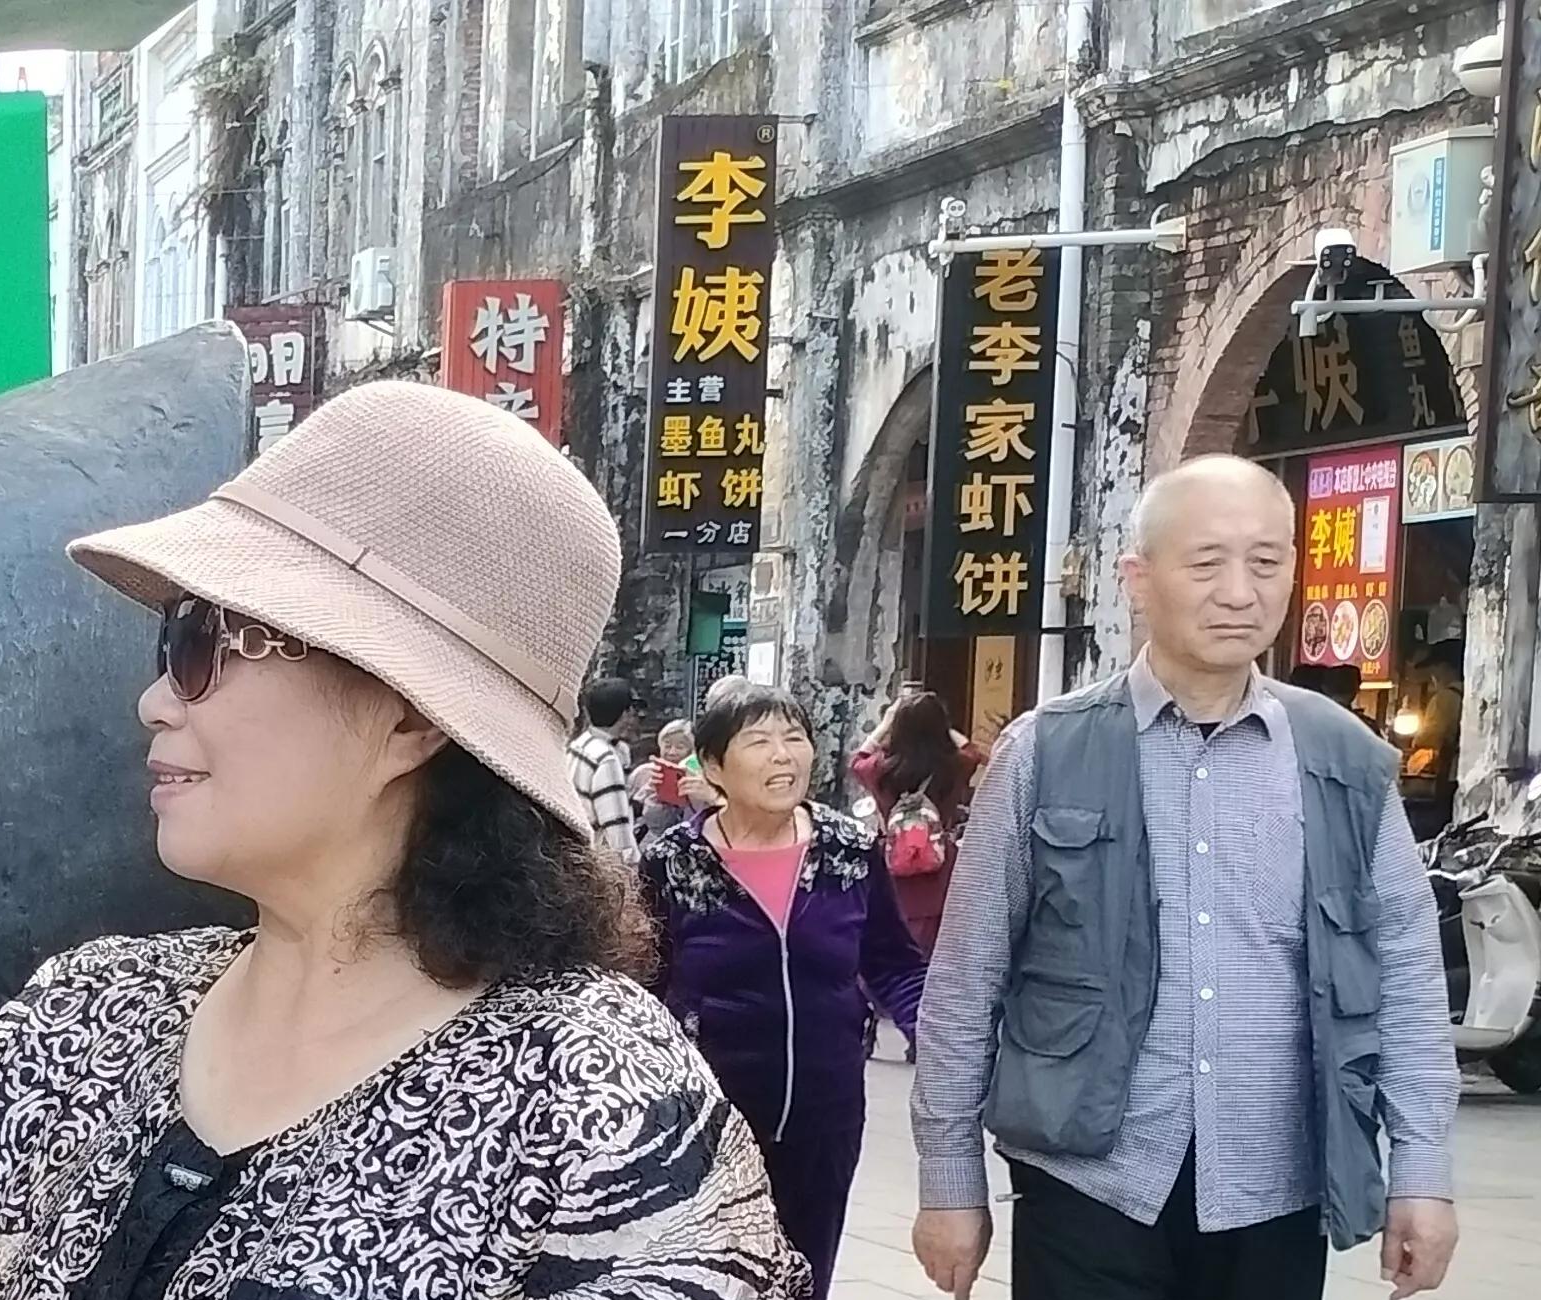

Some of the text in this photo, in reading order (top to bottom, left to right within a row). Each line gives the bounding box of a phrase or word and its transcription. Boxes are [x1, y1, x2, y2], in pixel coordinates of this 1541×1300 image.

[671, 151, 767, 363] 李姨
[665, 375, 725, 403] 主营
[660, 413, 766, 457] 墨鱼丸
[954, 248, 1044, 616] 老李家虾饼
[657, 467, 762, 511] 虾饼
[663, 520, 753, 545] 一分店
[1308, 505, 1357, 570] 李姨
